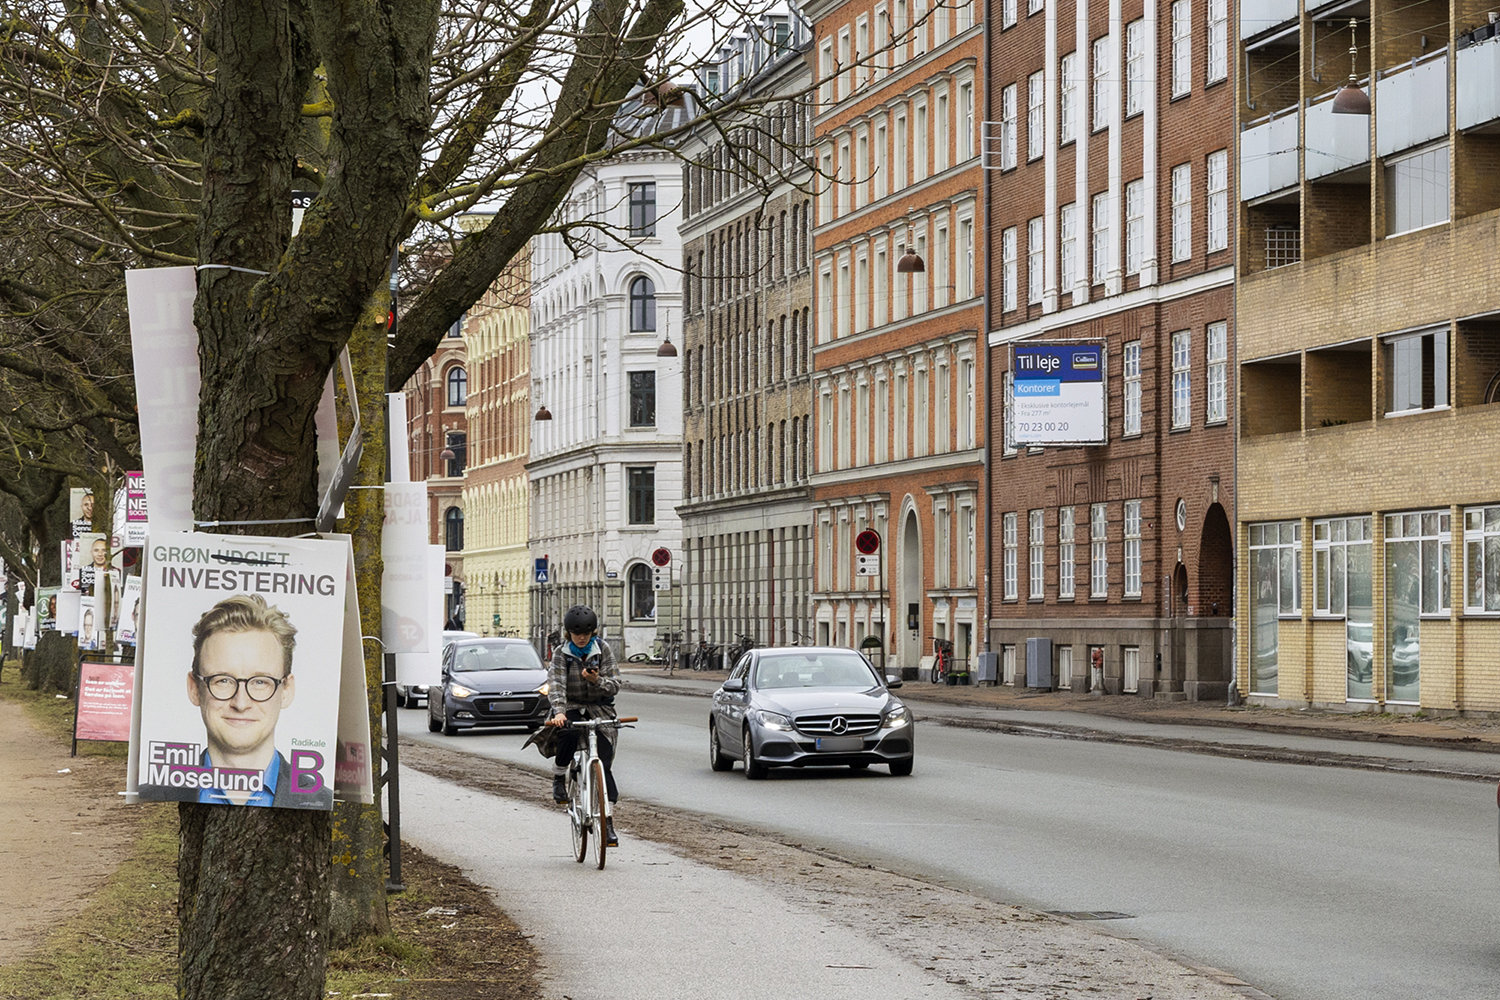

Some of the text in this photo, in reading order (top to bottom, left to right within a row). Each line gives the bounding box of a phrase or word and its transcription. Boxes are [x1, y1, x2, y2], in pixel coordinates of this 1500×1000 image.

[1017, 353, 1060, 373] Til leje
[1017, 384, 1056, 393] Kontorer
[1018, 422, 1068, 431] 70 23 00 20
[128, 478, 146, 489] NE
[128, 498, 148, 510] NE
[153, 545, 209, 564] GRØN
[161, 566, 336, 597] INVESTERING
[291, 737, 326, 748] Radikale
[149, 742, 200, 766] Emil
[149, 764, 264, 792] Moselund
[290, 749, 325, 794] B
